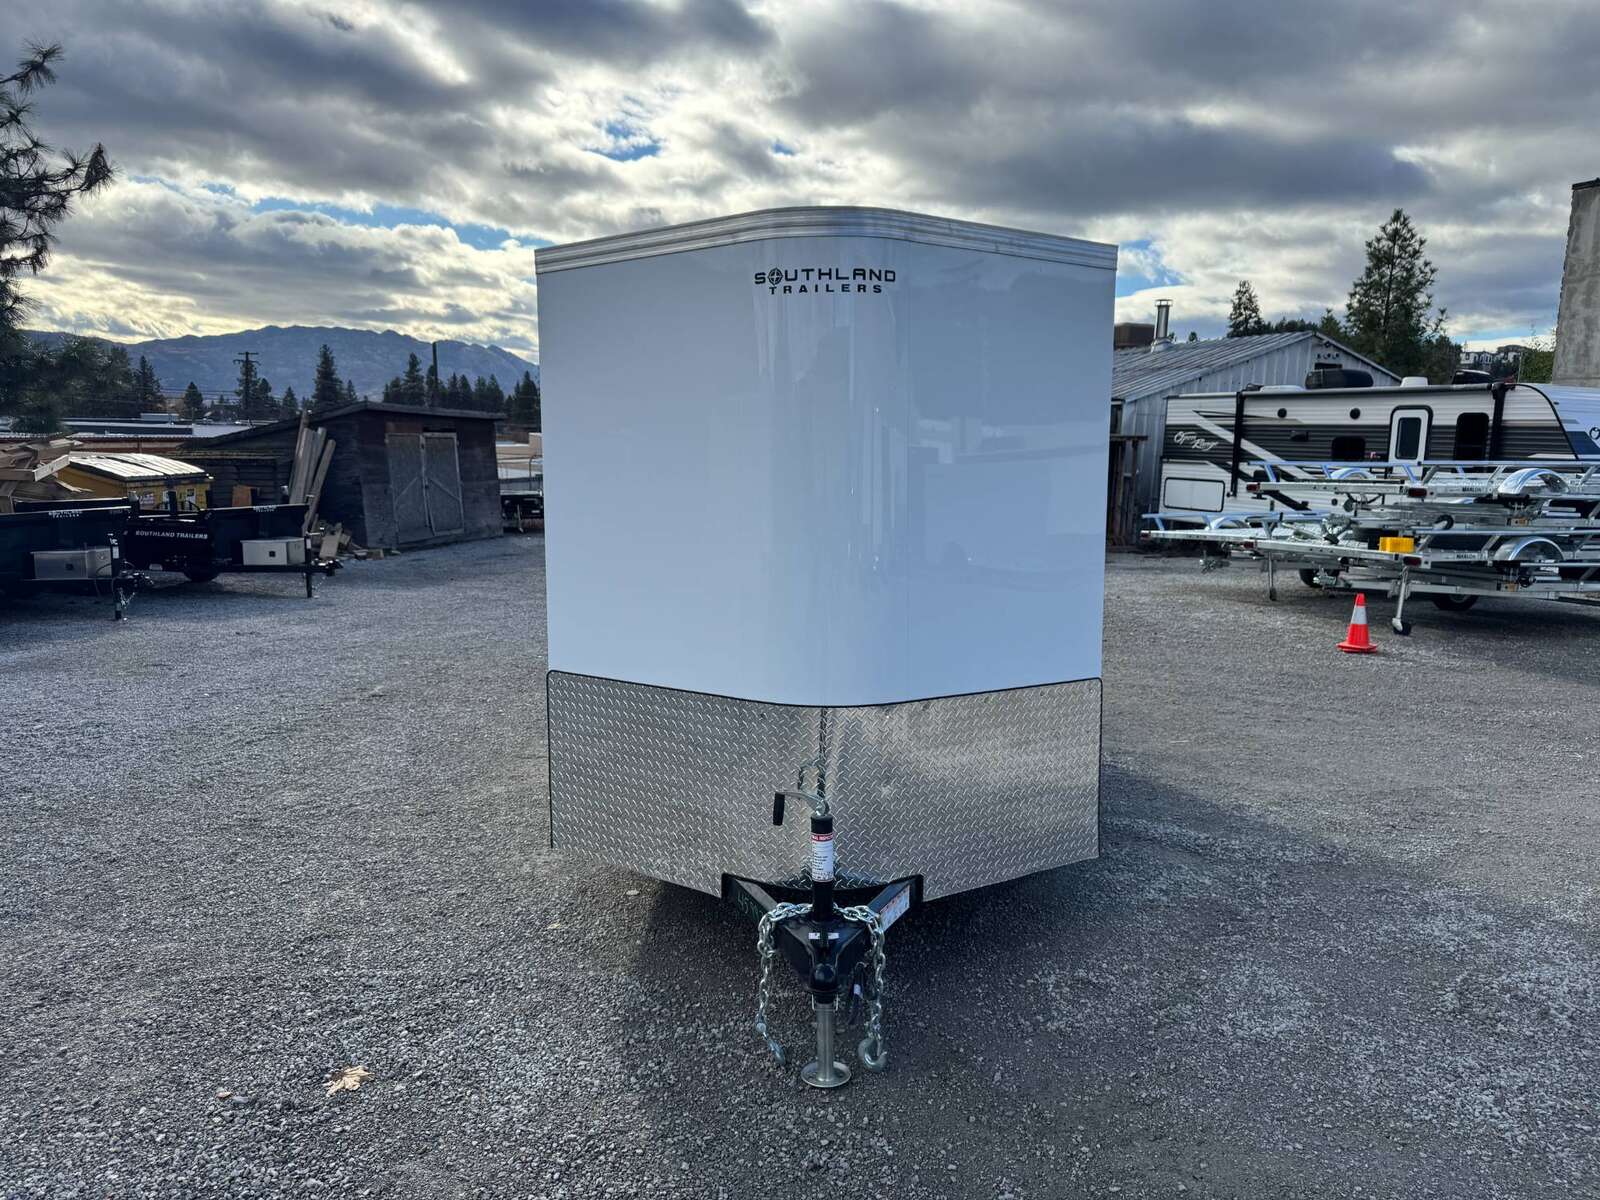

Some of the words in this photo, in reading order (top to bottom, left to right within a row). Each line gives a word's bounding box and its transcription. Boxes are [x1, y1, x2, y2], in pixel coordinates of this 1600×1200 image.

[754, 267, 896, 285] SOUTHLAND
[769, 284, 883, 295] TRAILERS
[135, 530, 175, 538] SOUTHLAND
[176, 532, 209, 540] TRAILERS
